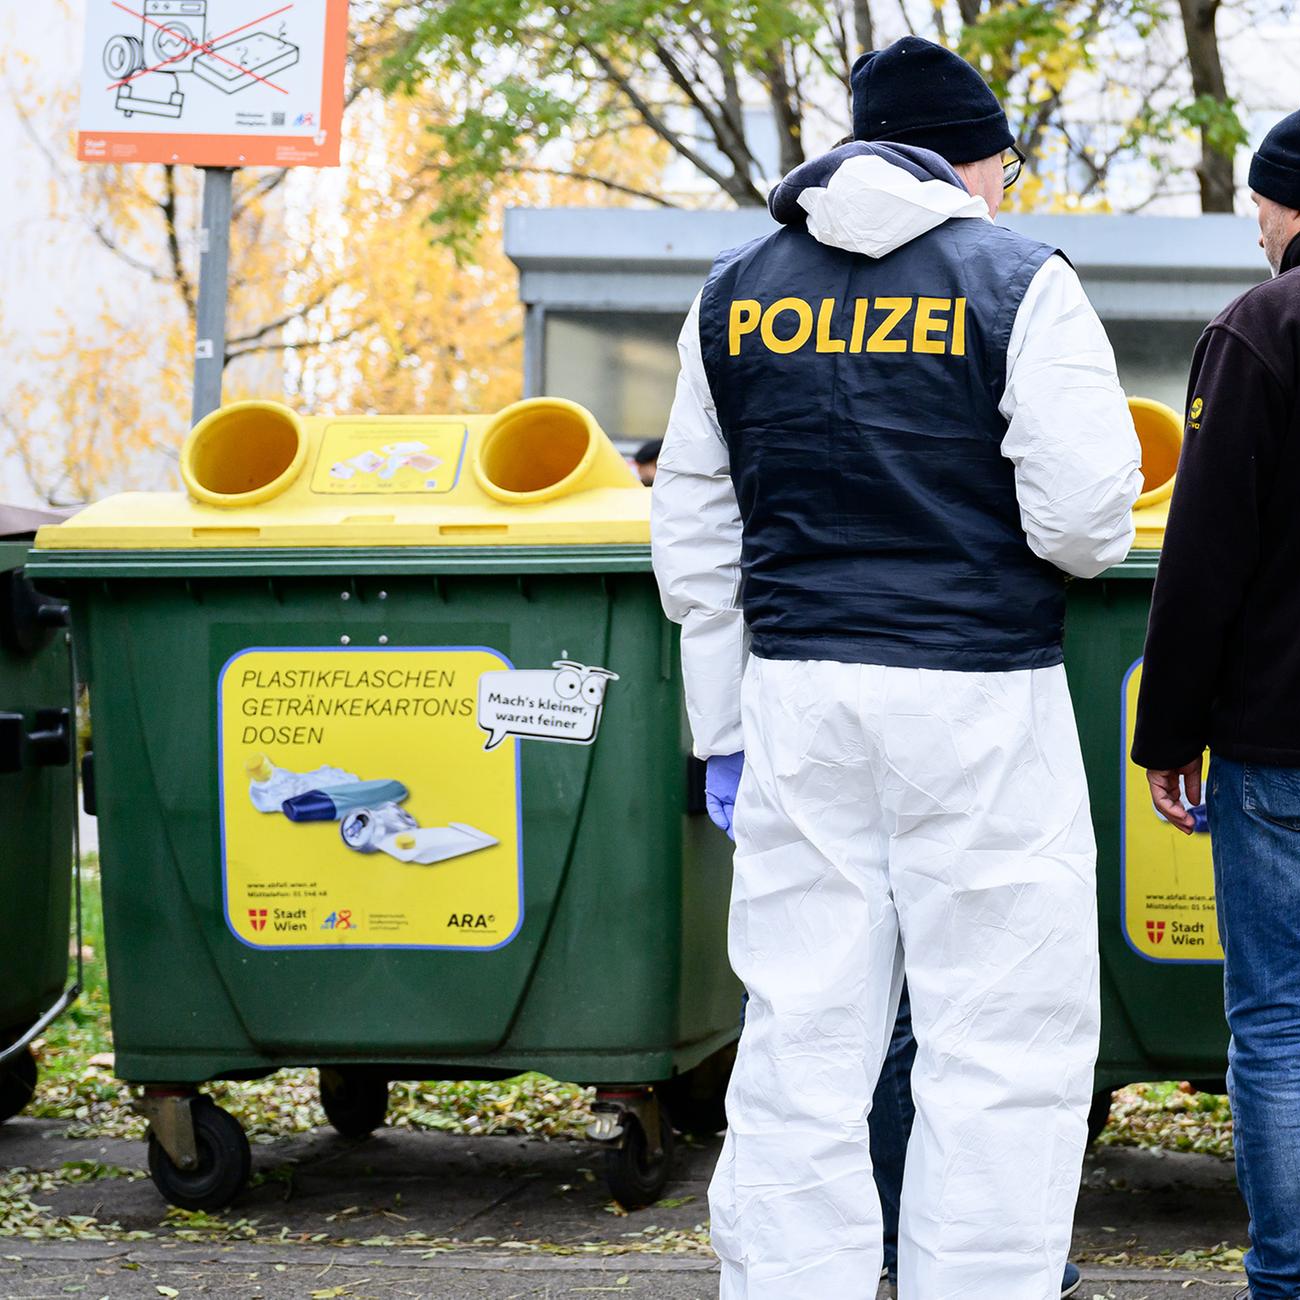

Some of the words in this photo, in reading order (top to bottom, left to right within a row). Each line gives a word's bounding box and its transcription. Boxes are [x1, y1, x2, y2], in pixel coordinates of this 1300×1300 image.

[728, 296, 967, 357] POLIZEI
[241, 669, 455, 689] PLASTIKFLASCHEN
[241, 694, 474, 718] GETRÄNKEKARTONS
[488, 692, 535, 708] Mach's
[538, 698, 588, 717] kleiner,
[495, 712, 534, 725] warat
[537, 714, 578, 730] feiner
[241, 726, 324, 745] DOSEN
[273, 908, 307, 920] Stadt
[446, 913, 488, 929] ARA
[273, 921, 308, 932] Wien
[1170, 920, 1205, 933] Stadt
[1170, 933, 1205, 946] Wien
